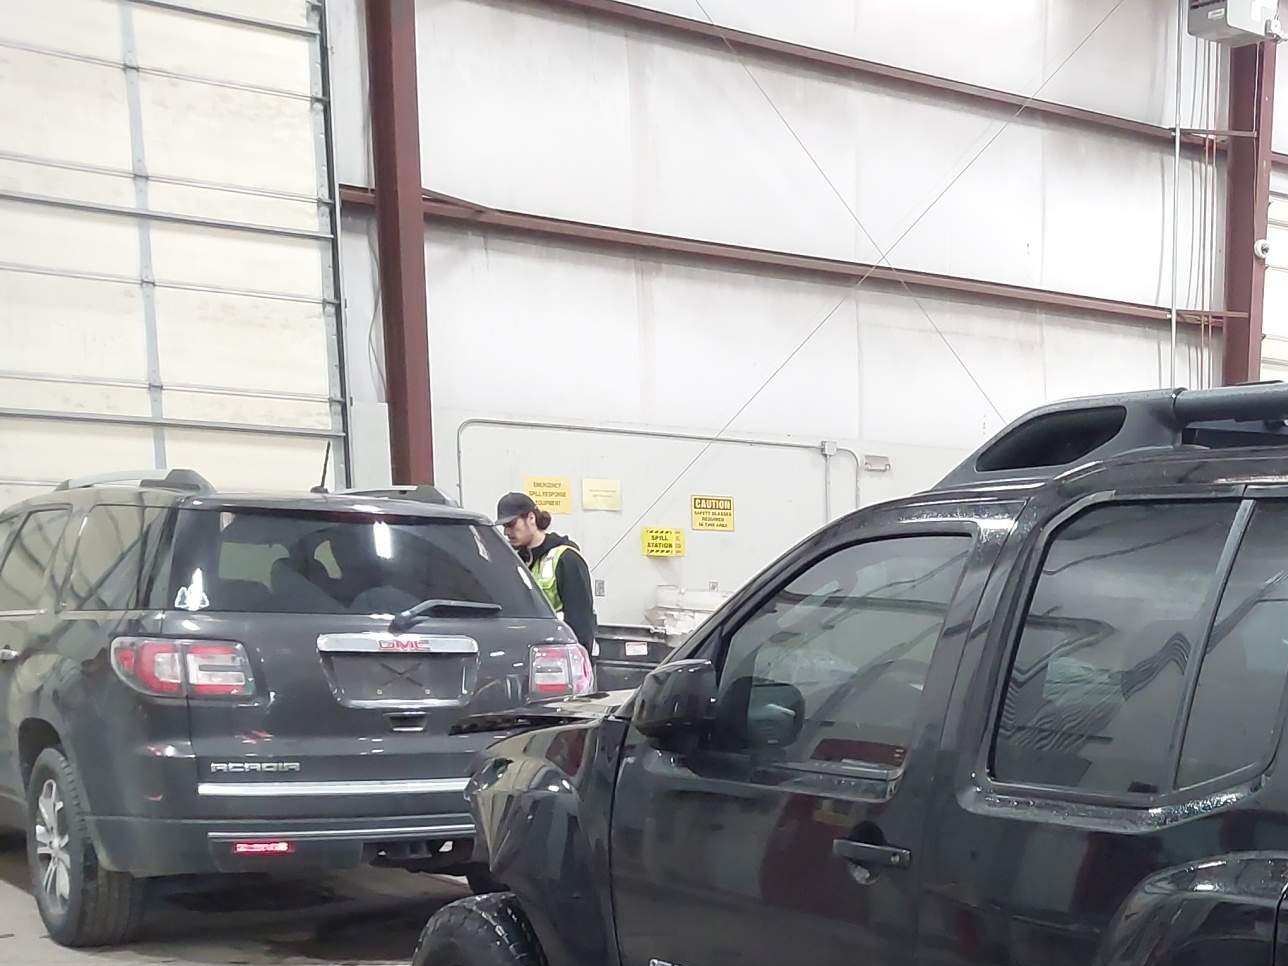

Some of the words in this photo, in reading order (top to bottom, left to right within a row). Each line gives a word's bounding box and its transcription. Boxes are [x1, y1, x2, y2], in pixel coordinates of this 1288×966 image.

[695, 499, 731, 510] CAUTION
[378, 639, 432, 651] GMC
[210, 762, 301, 773] ACADIA
